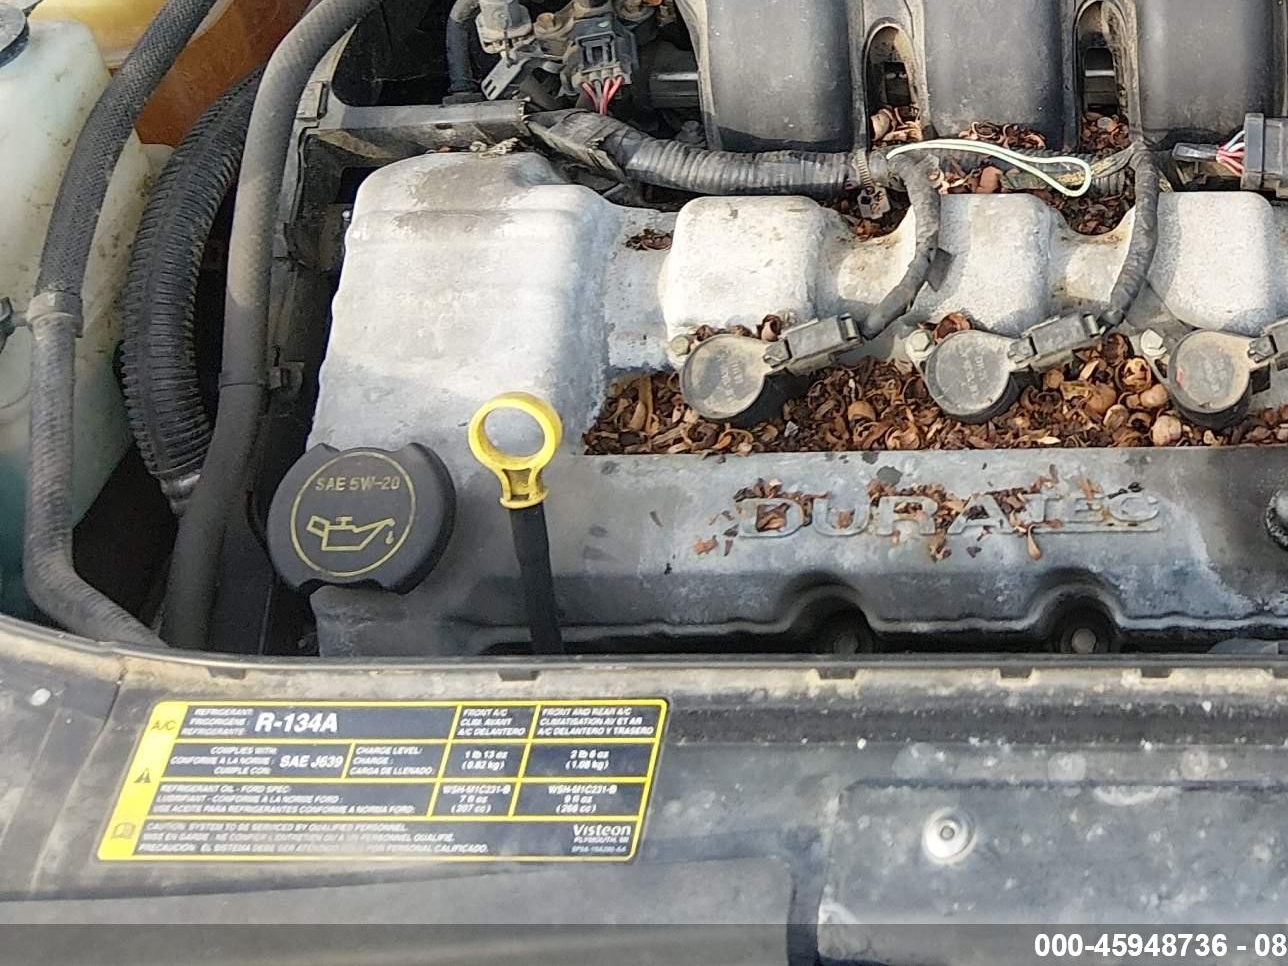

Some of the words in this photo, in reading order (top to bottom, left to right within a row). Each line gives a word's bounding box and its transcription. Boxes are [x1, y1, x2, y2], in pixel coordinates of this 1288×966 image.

[315, 477, 347, 490] SAE
[349, 476, 401, 490] 5W-20
[151, 720, 175, 731] A/C
[254, 712, 338, 733] R-134A
[474, 727, 526, 736] DELANTERO
[554, 727, 606, 736] DELANTERO
[613, 727, 654, 736] TRASERO
[355, 746, 391, 755] CHARGE
[279, 755, 310, 768] SAE
[311, 755, 344, 768] J639
[573, 824, 631, 836] Visteon
